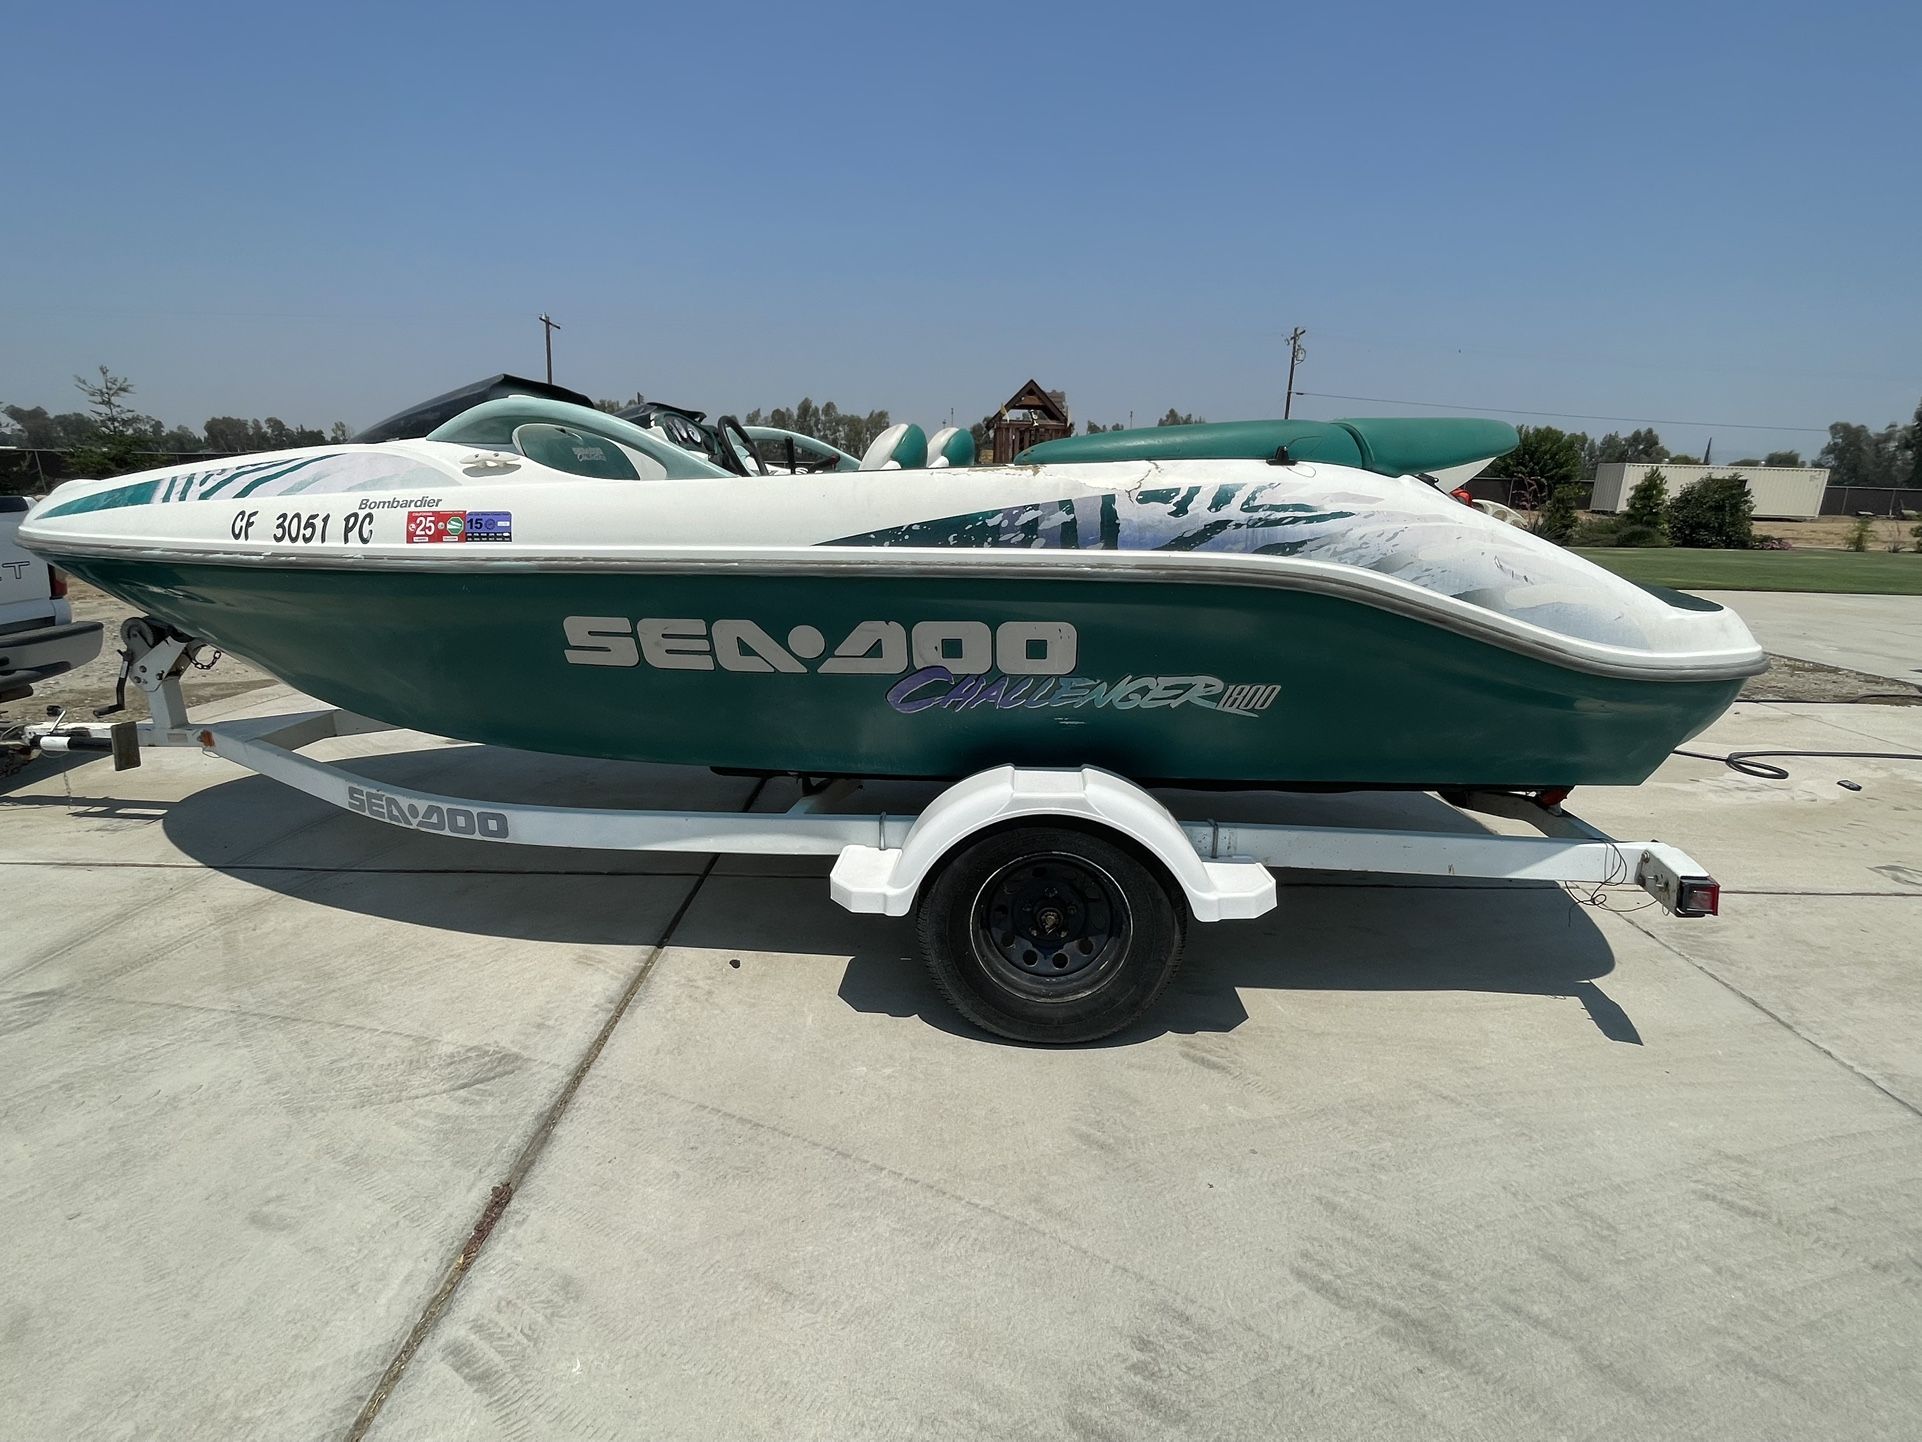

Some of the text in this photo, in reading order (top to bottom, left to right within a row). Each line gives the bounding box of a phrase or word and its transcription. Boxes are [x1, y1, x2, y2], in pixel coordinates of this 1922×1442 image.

[358, 496, 443, 510] Bombardier
[231, 510, 374, 545] CF 3051 PC
[415, 516, 435, 536] 25
[467, 518, 483, 530] 15
[0, 561, 30, 581] T
[886, 665, 1282, 718] CHALLENGER 1800
